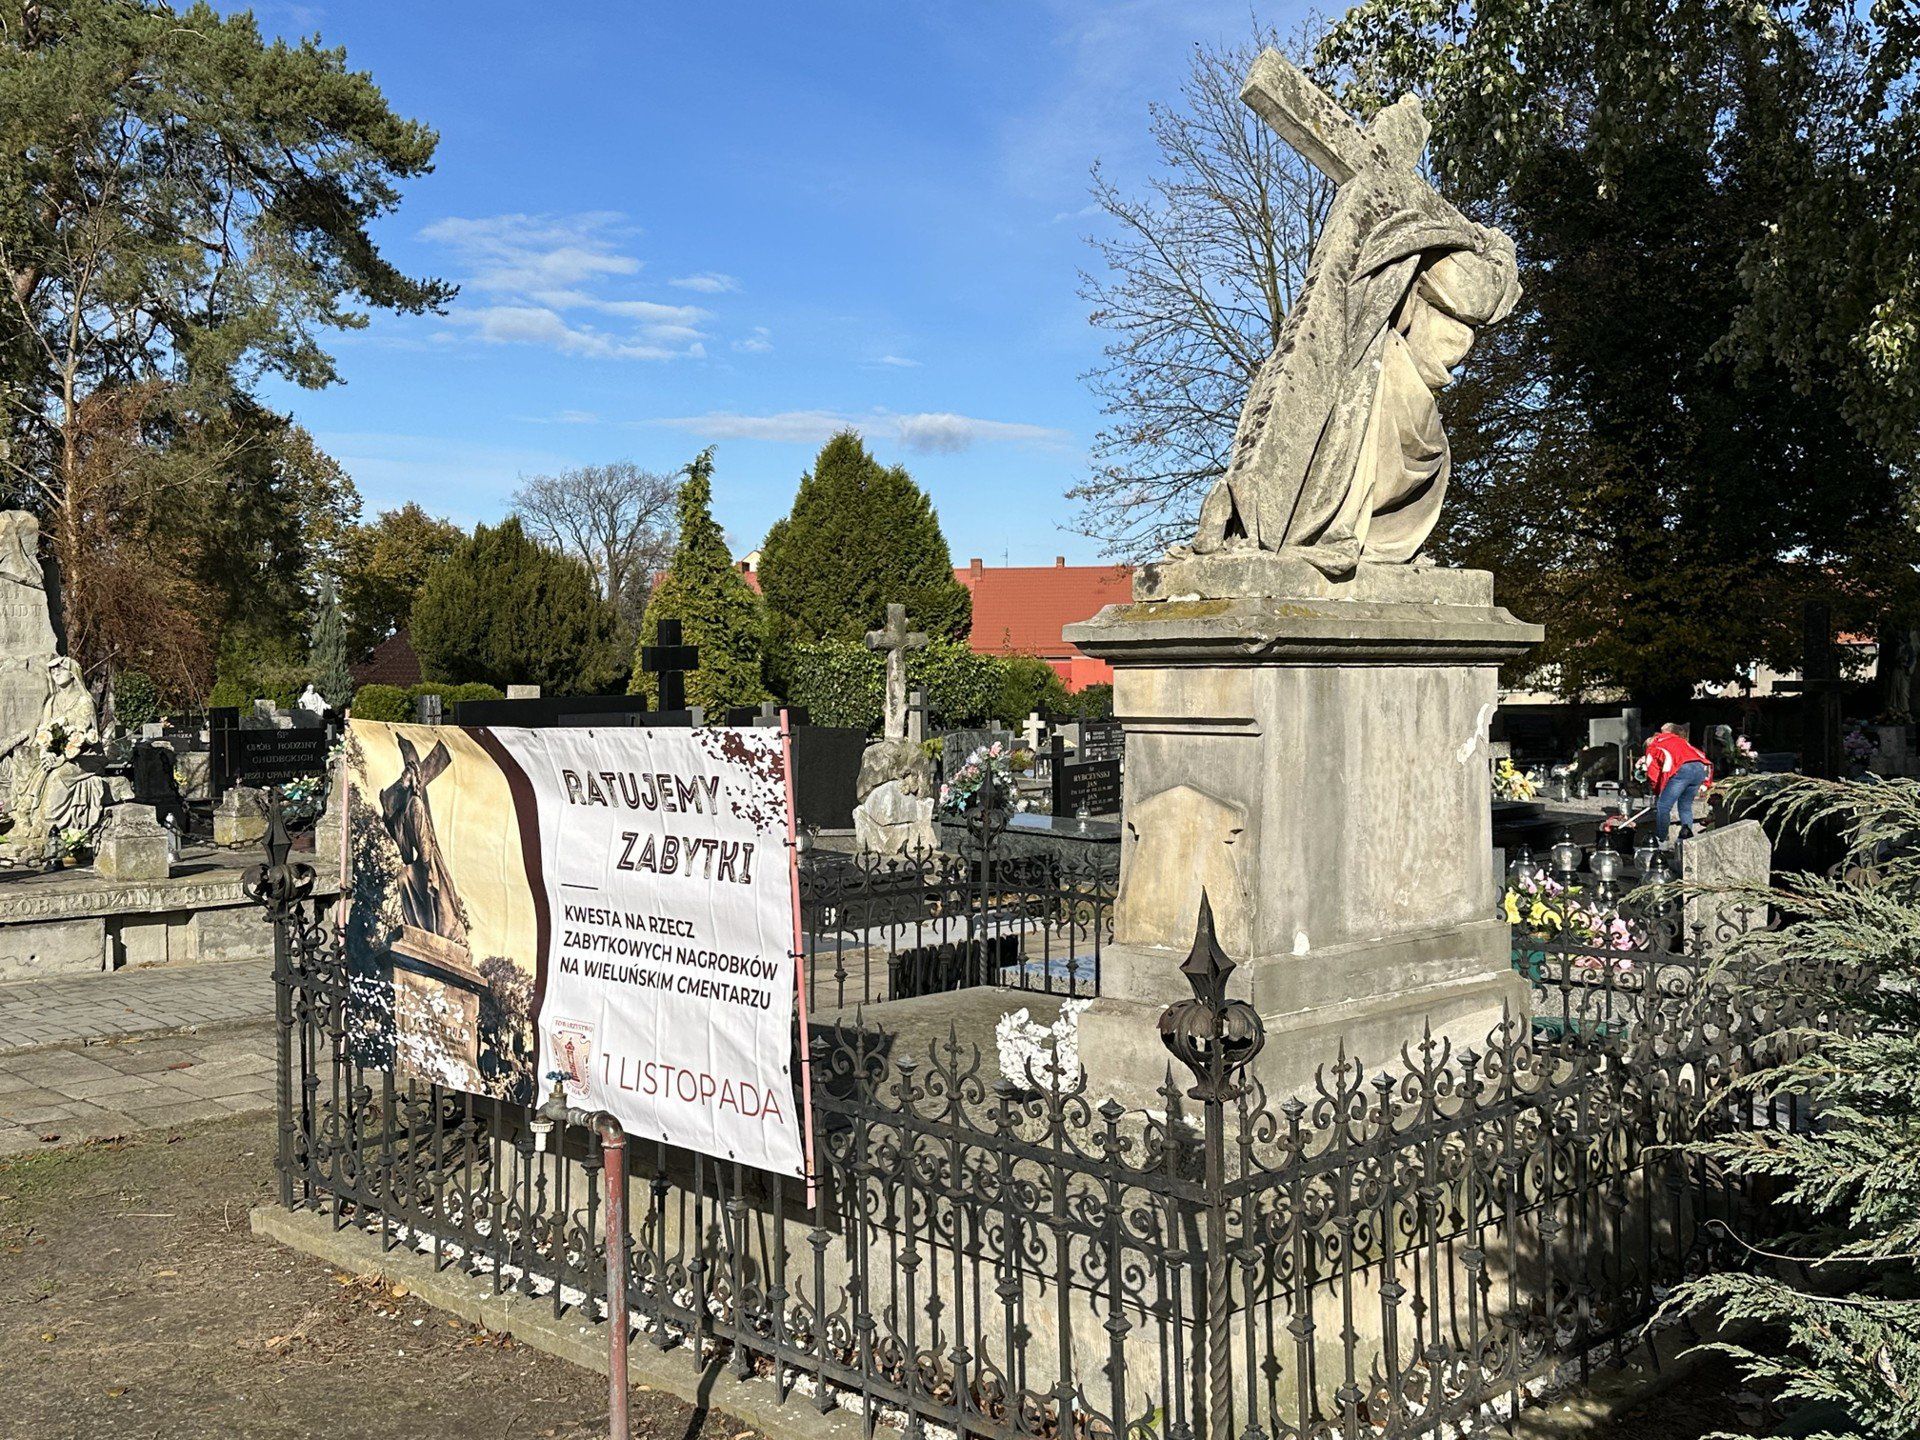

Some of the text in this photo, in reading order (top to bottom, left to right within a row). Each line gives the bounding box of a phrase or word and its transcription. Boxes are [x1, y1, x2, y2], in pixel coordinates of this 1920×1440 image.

[277, 741, 318, 750] RODZINY
[562, 769, 720, 815] RATUJEMY
[616, 831, 755, 885] ZABYTKI
[564, 904, 695, 939] KWESTA NA RZECZ
[563, 930, 778, 981] ZABYTKOWYCH NAGROBKÓW
[560, 956, 771, 1010] NA WIELUŃSKIM CMENTARZU
[602, 1053, 610, 1086] 1
[619, 1056, 784, 1124] LISTOPADA
